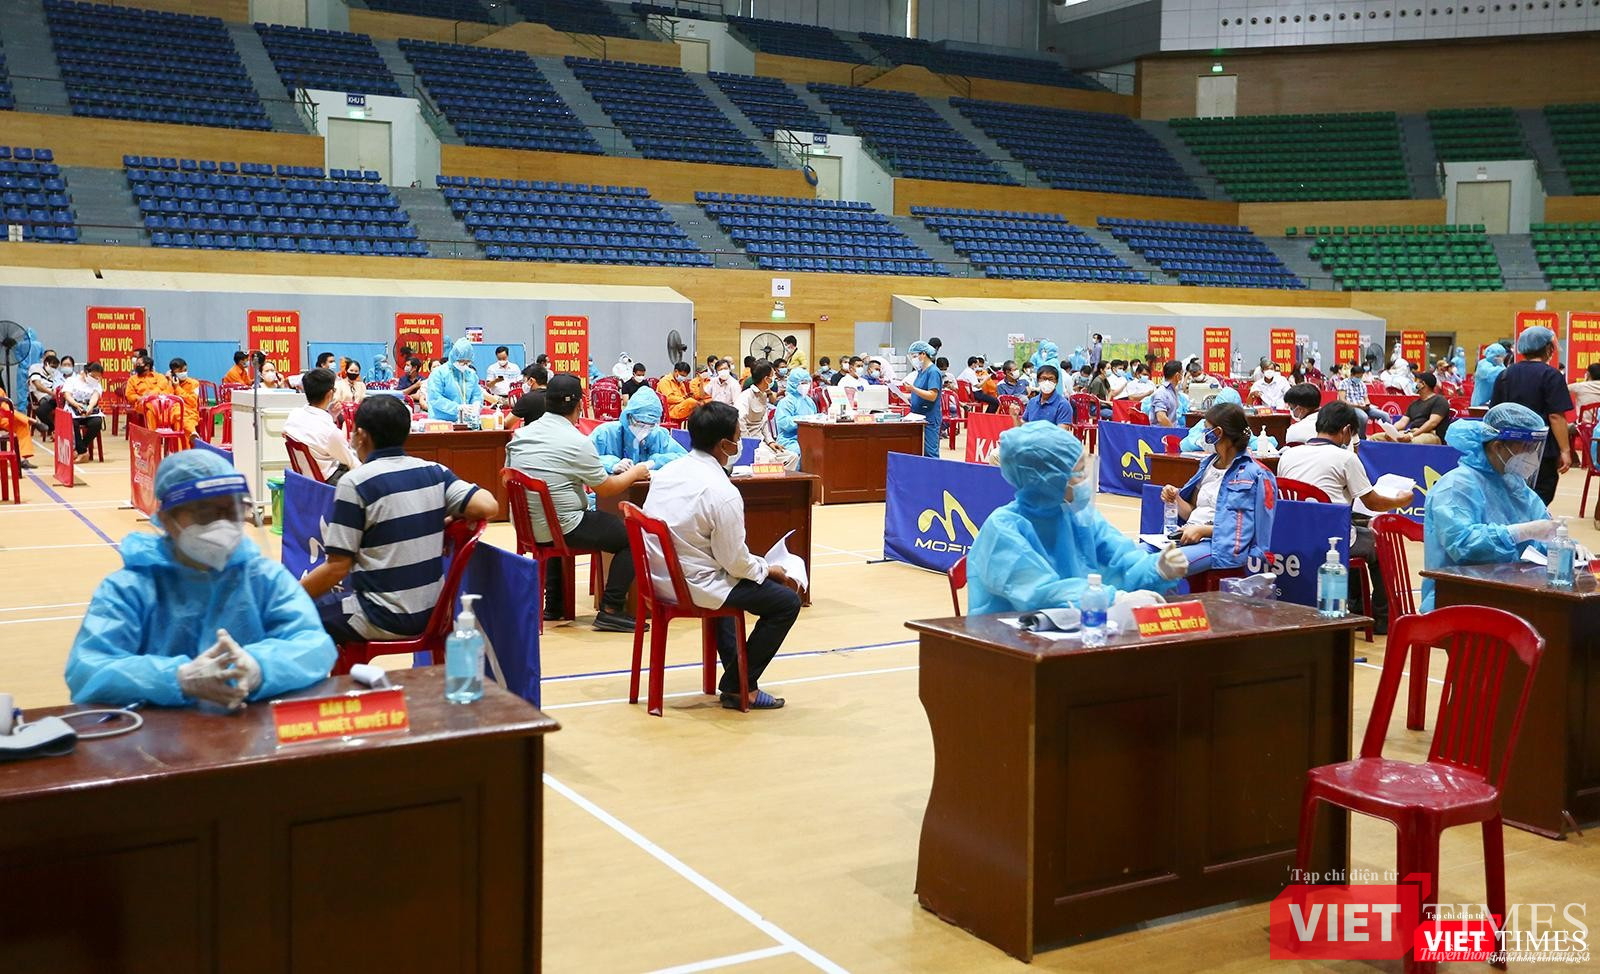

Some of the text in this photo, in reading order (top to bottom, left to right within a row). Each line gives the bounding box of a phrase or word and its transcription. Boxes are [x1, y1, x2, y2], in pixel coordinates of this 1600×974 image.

[100, 336, 133, 355] KHU VỰC
[260, 339, 289, 355] KHU VỰC
[555, 341, 580, 356] KHU VỰC
[99, 358, 119, 372] THEO
[555, 360, 569, 372] THEO
[915, 538, 972, 555] MOFI
[319, 700, 344, 717] BÀN
